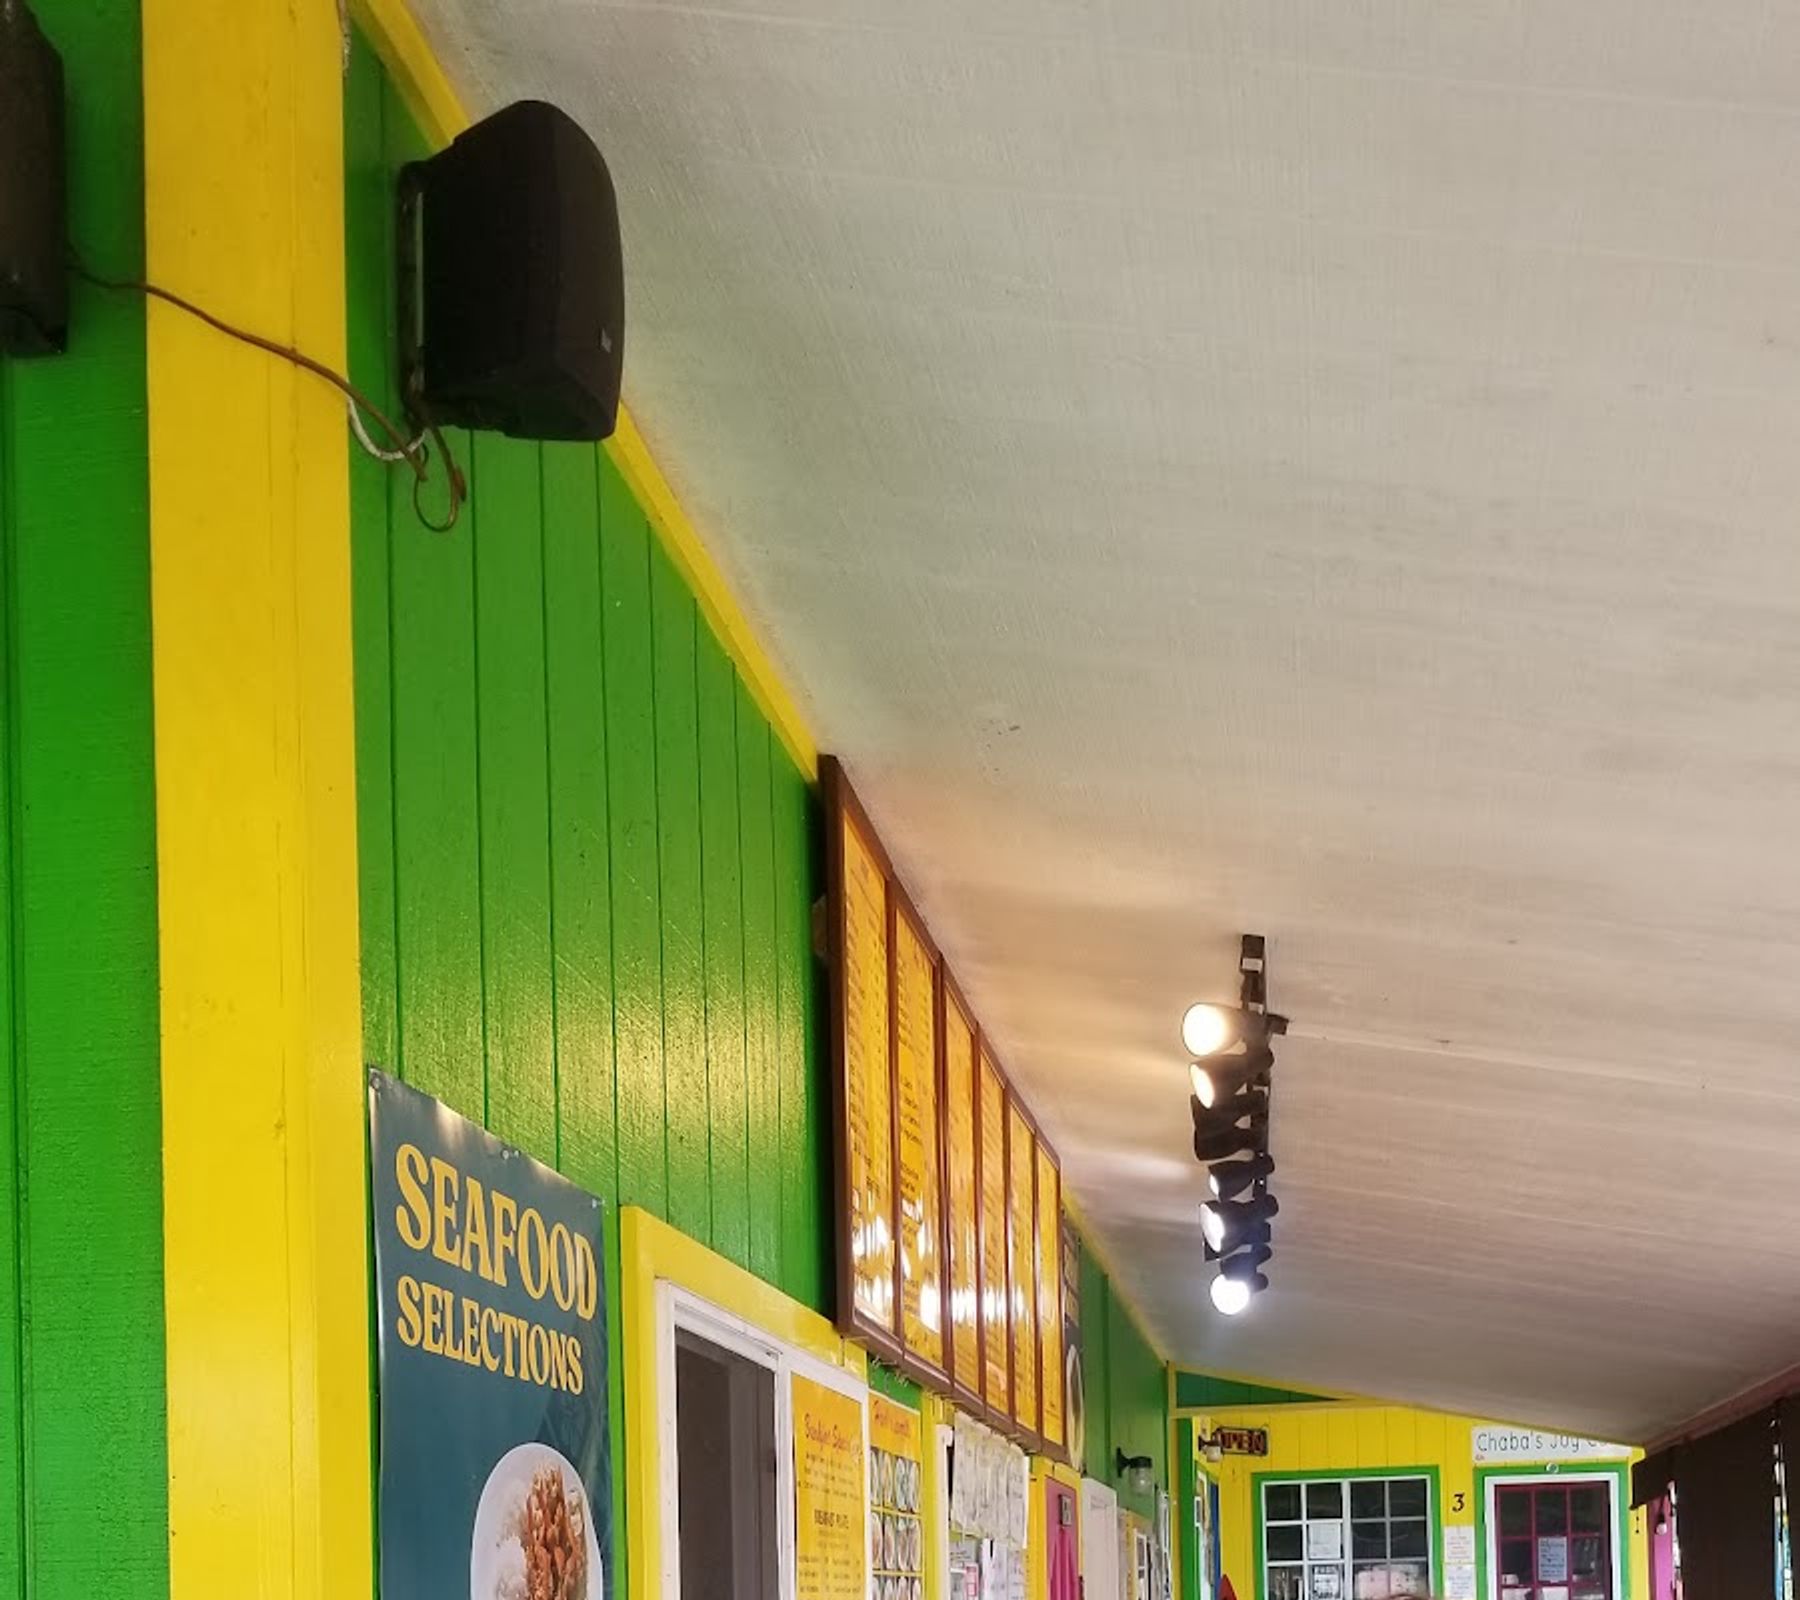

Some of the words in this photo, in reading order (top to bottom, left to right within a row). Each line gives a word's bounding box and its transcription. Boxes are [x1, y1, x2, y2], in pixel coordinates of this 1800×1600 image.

[395, 1143, 597, 1321] SEAFOOD
[396, 1274, 584, 1395] SELECTIONS
[1477, 1430, 1543, 1451] Chaba's
[1452, 1492, 1465, 1512] 3
